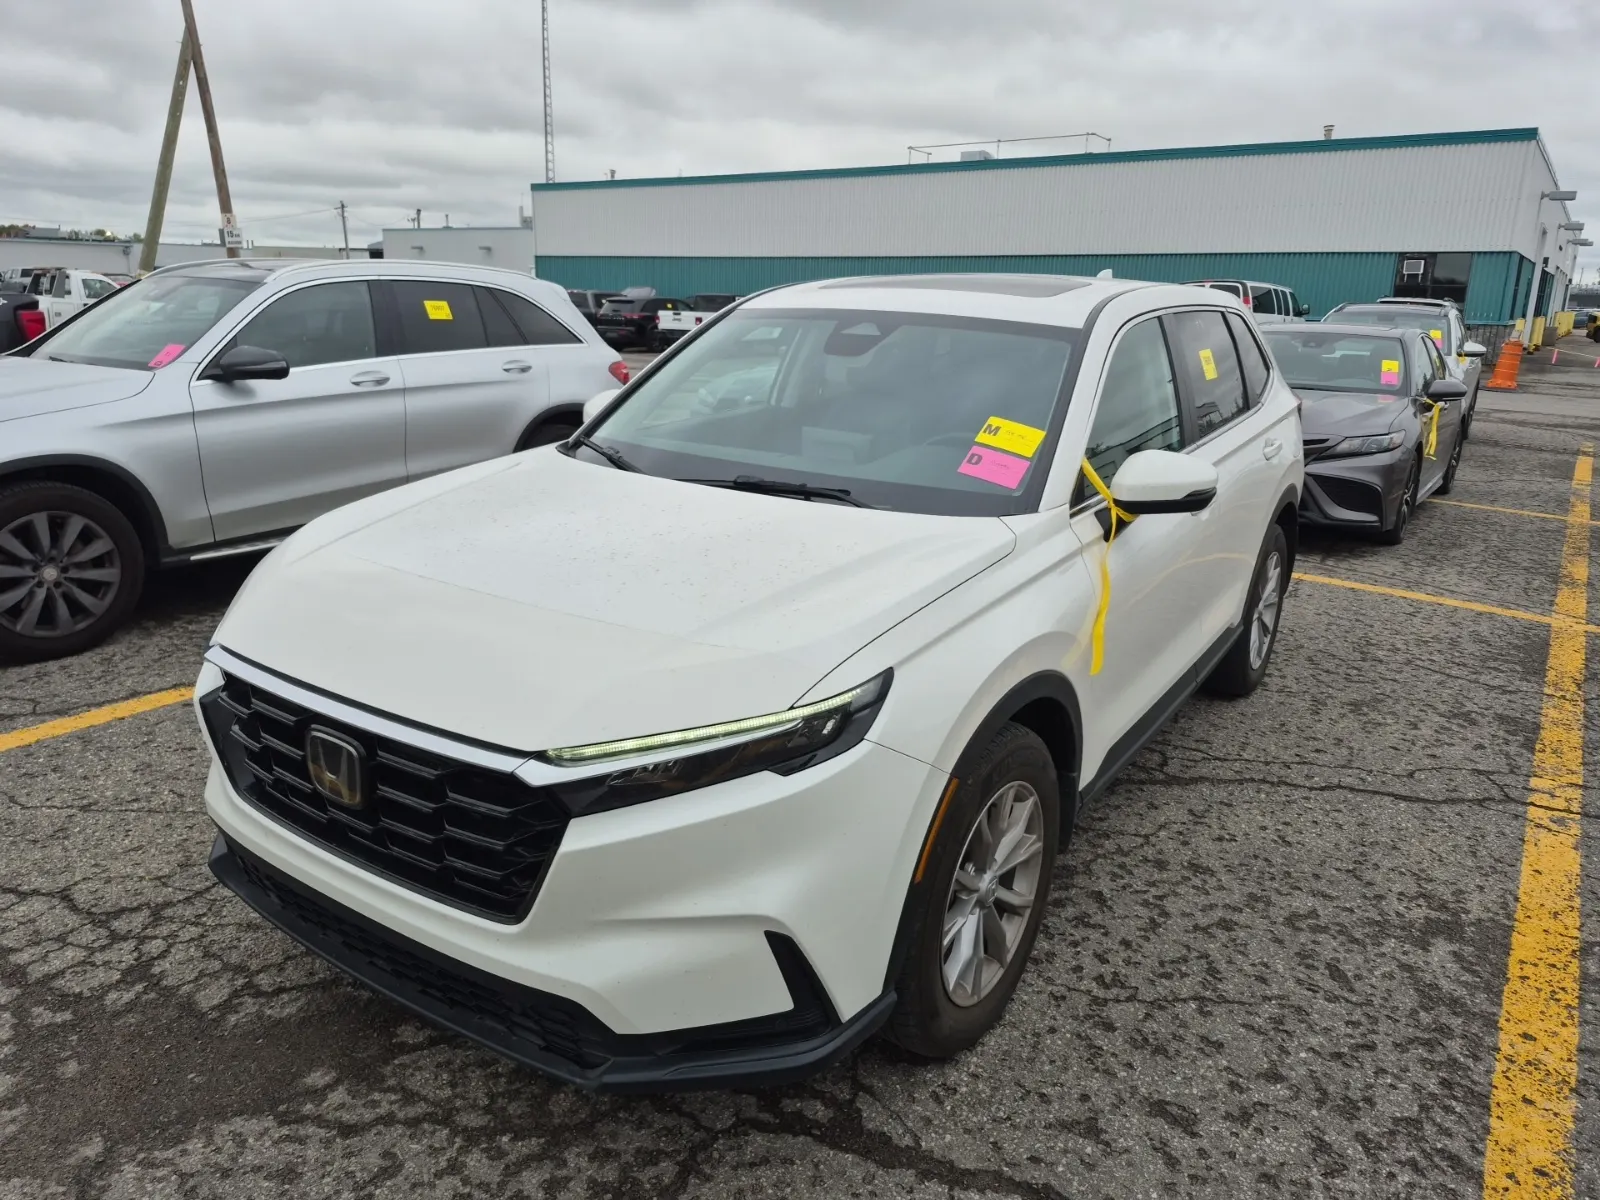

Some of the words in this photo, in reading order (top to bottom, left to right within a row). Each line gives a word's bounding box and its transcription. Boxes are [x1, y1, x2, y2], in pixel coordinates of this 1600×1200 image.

[226, 230, 234, 238] 15
[982, 423, 1002, 437] M
[966, 453, 983, 465] D
